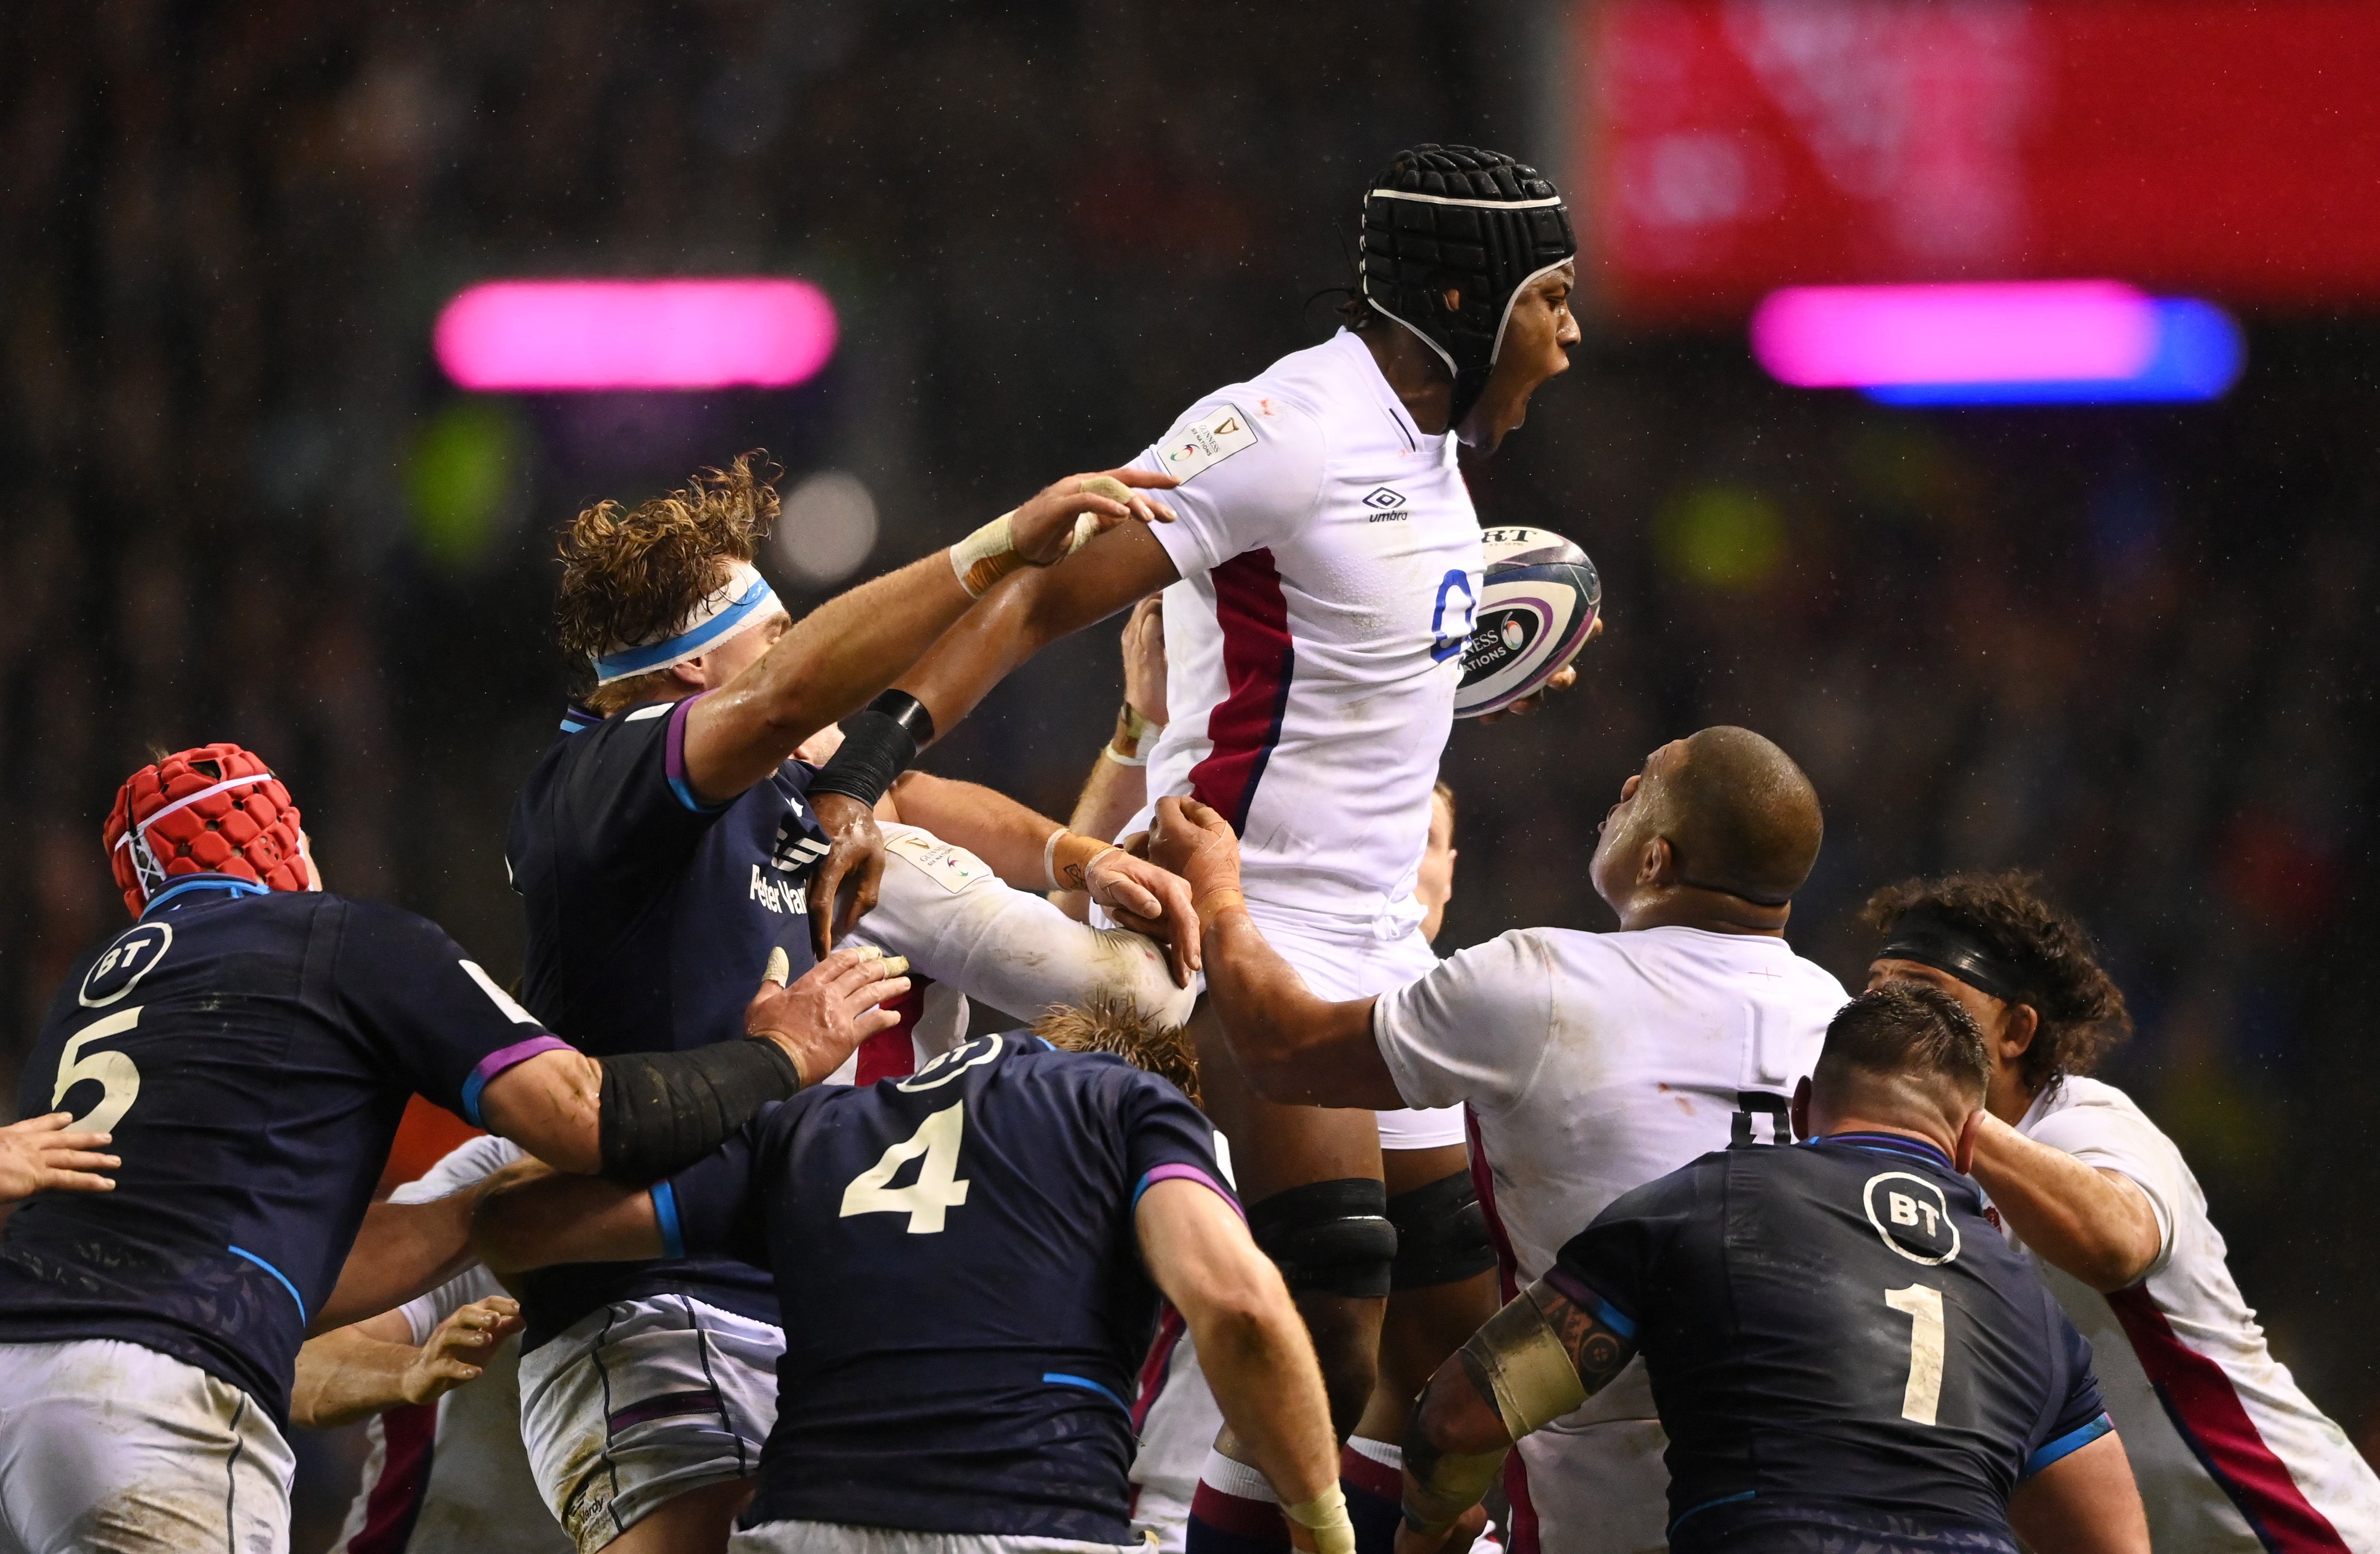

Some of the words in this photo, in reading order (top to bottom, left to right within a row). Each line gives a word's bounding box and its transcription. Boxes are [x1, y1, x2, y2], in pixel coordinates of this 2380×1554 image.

[1196, 434, 1212, 456] NATIONS
[1199, 424, 1221, 453] GUINNESS
[1369, 510, 1407, 522] umbro
[750, 864, 782, 913] Peter
[93, 938, 151, 983] BT
[52, 1005, 145, 1134] 5
[917, 1041, 980, 1077] BT
[839, 1099, 970, 1233] 4
[1889, 1191, 1940, 1237] BT
[1884, 1283, 1945, 1426] 1
[579, 1497, 603, 1523] Vardy
